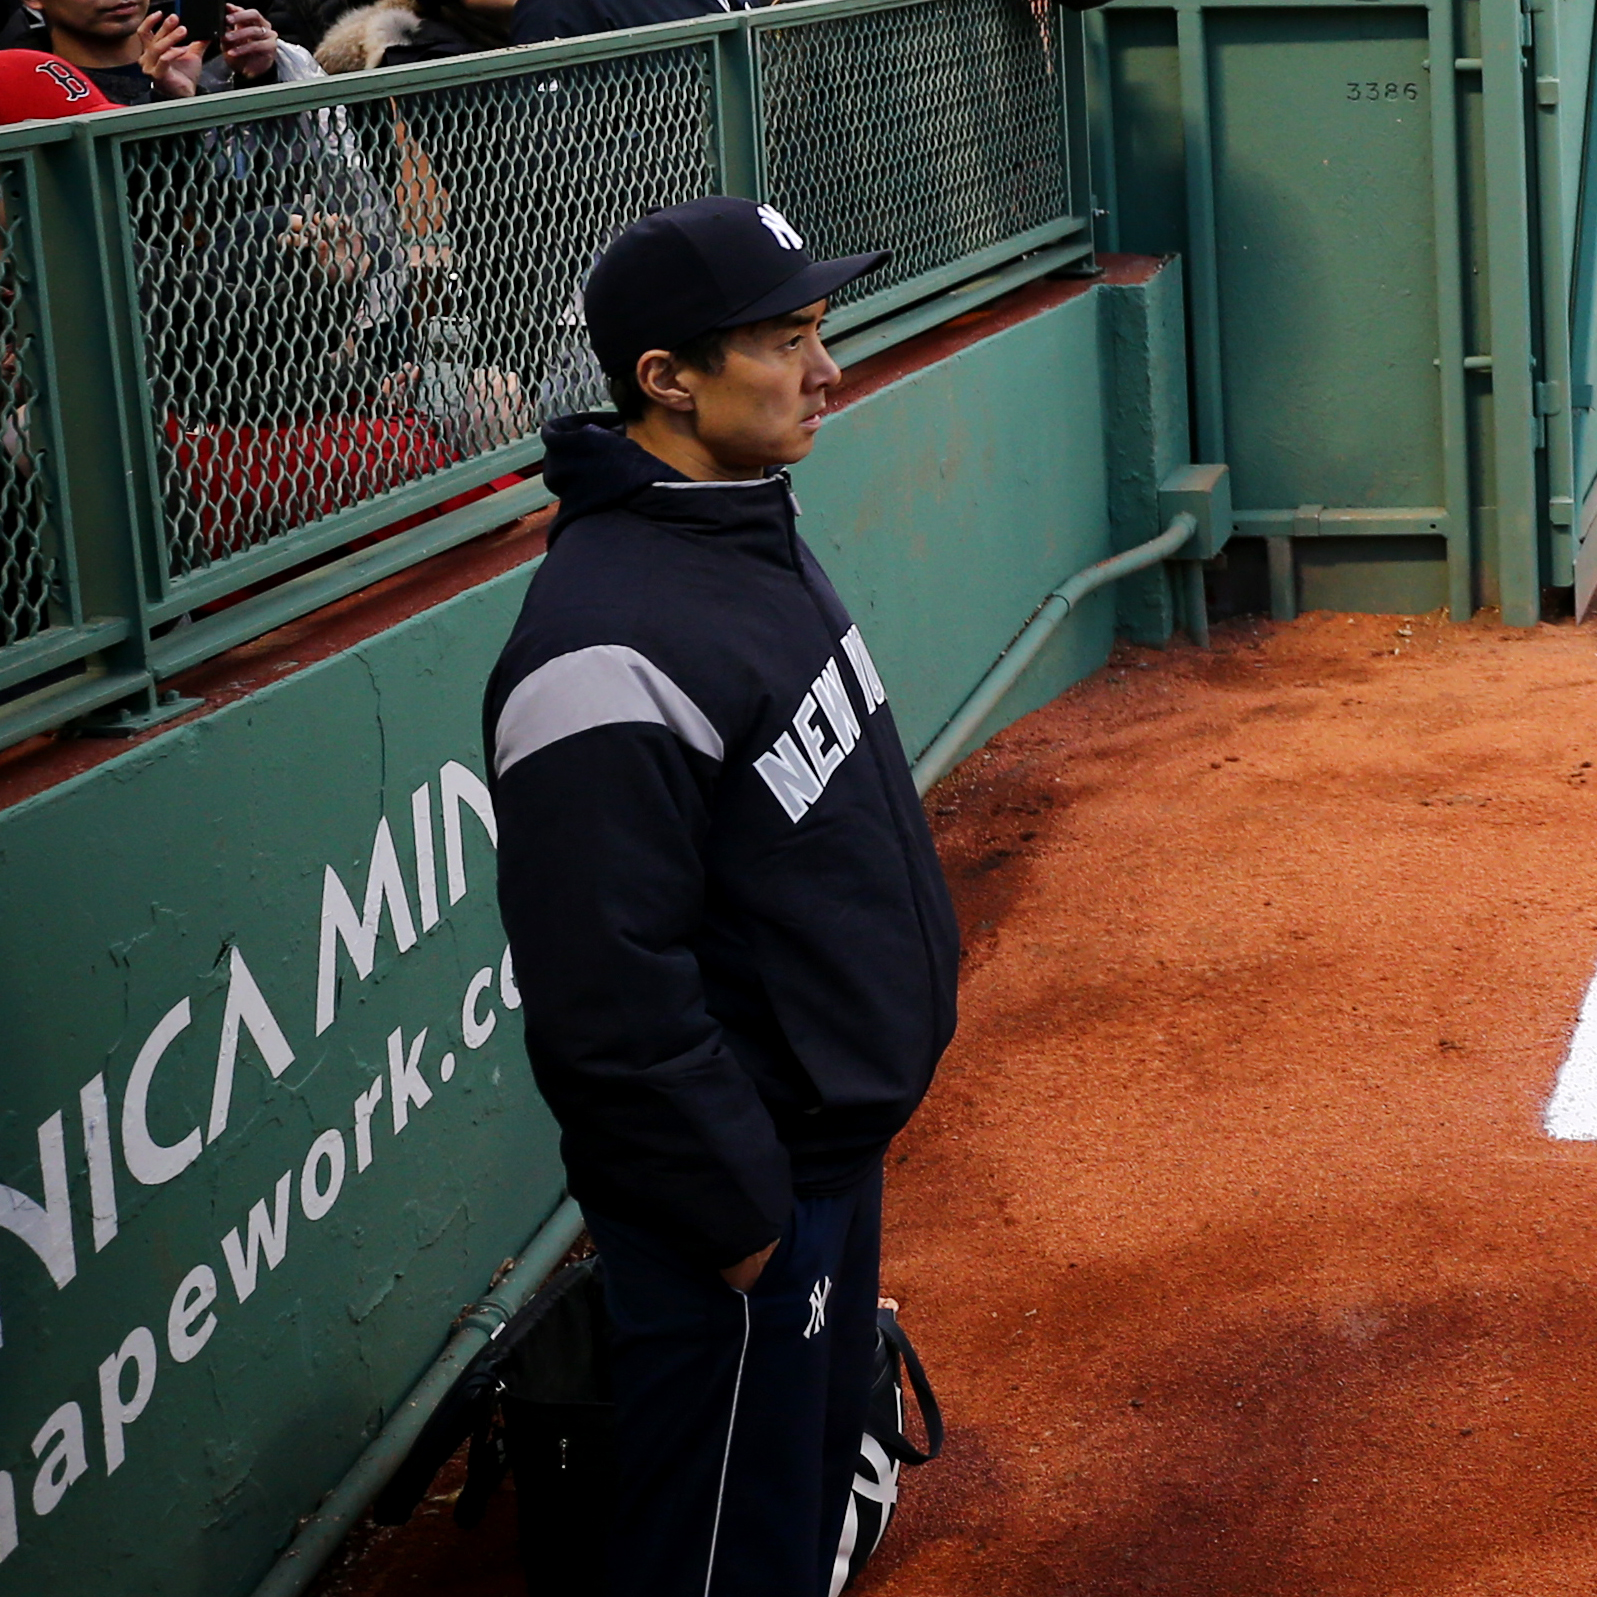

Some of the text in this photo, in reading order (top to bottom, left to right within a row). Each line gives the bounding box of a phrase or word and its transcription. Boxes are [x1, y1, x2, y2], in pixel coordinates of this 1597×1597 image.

[35, 60, 90, 102] B
[1346, 82, 1418, 101] 3386
[752, 656, 862, 824] NEW
